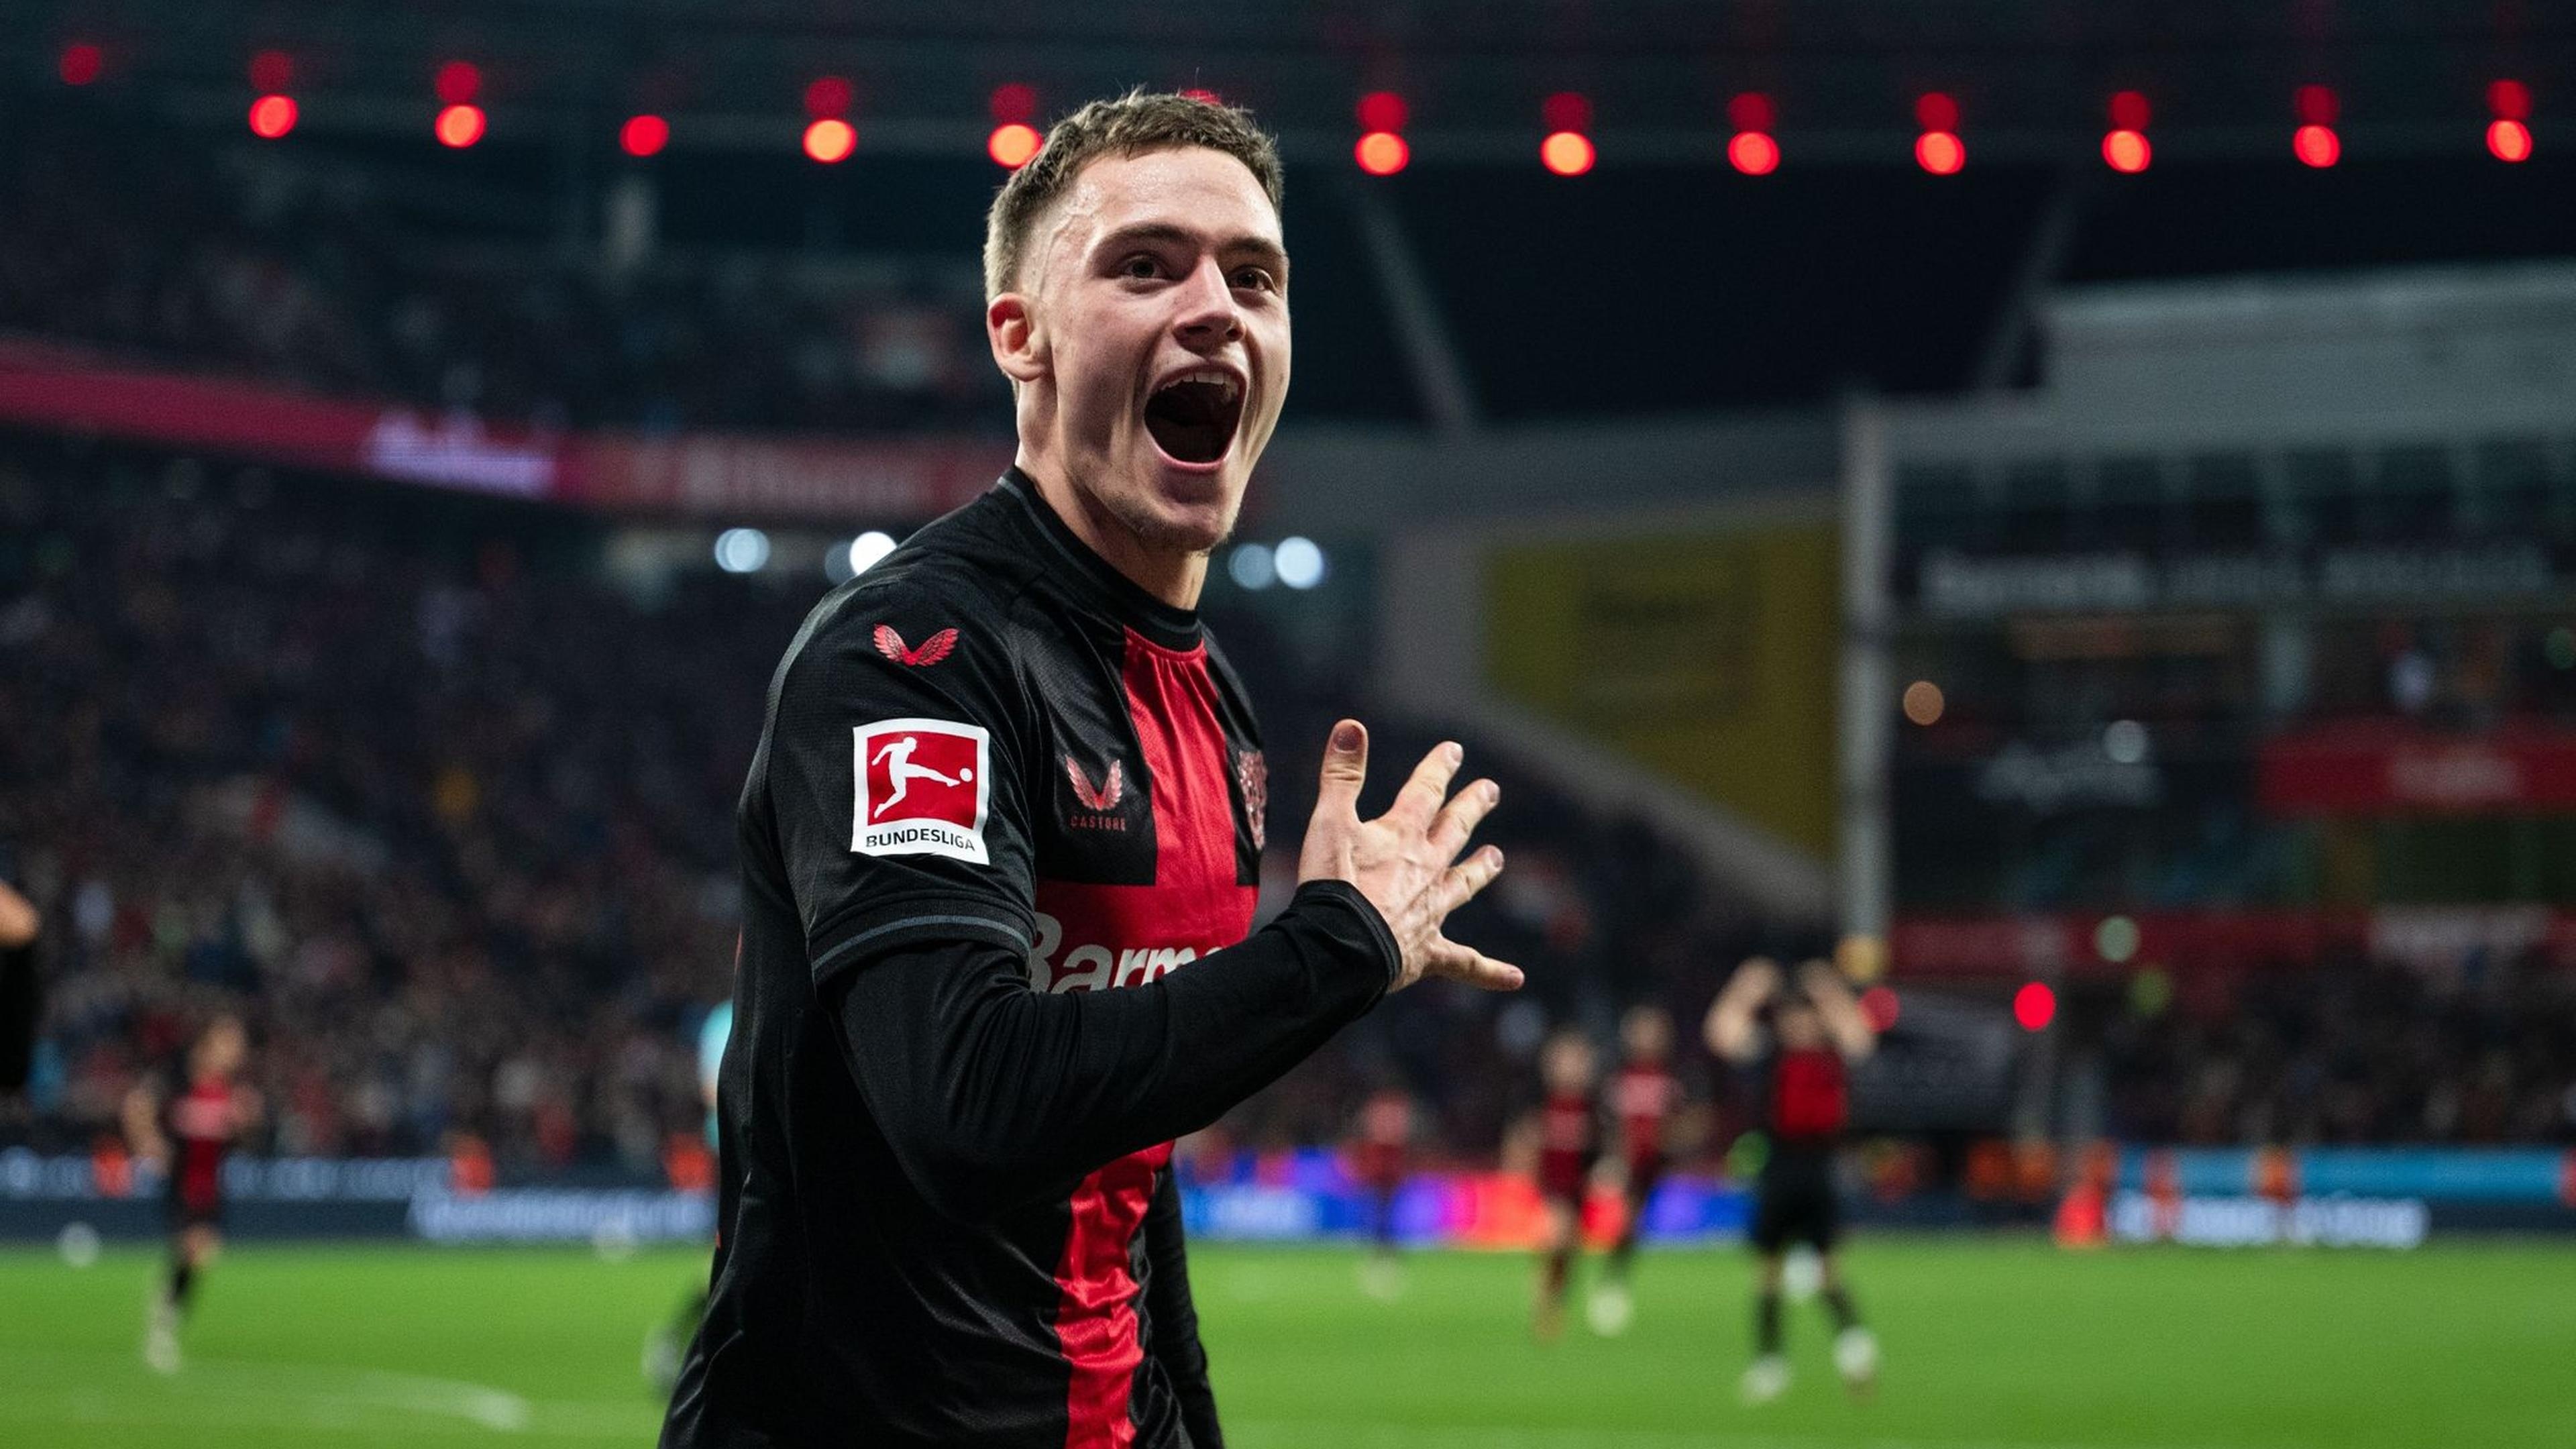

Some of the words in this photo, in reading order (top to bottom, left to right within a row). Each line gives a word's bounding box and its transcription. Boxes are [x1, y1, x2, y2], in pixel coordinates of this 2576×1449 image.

[1070, 815, 1126, 831] CASTORE
[866, 828, 975, 851] BUNDESLIGA
[1029, 912, 1222, 995] Barm
